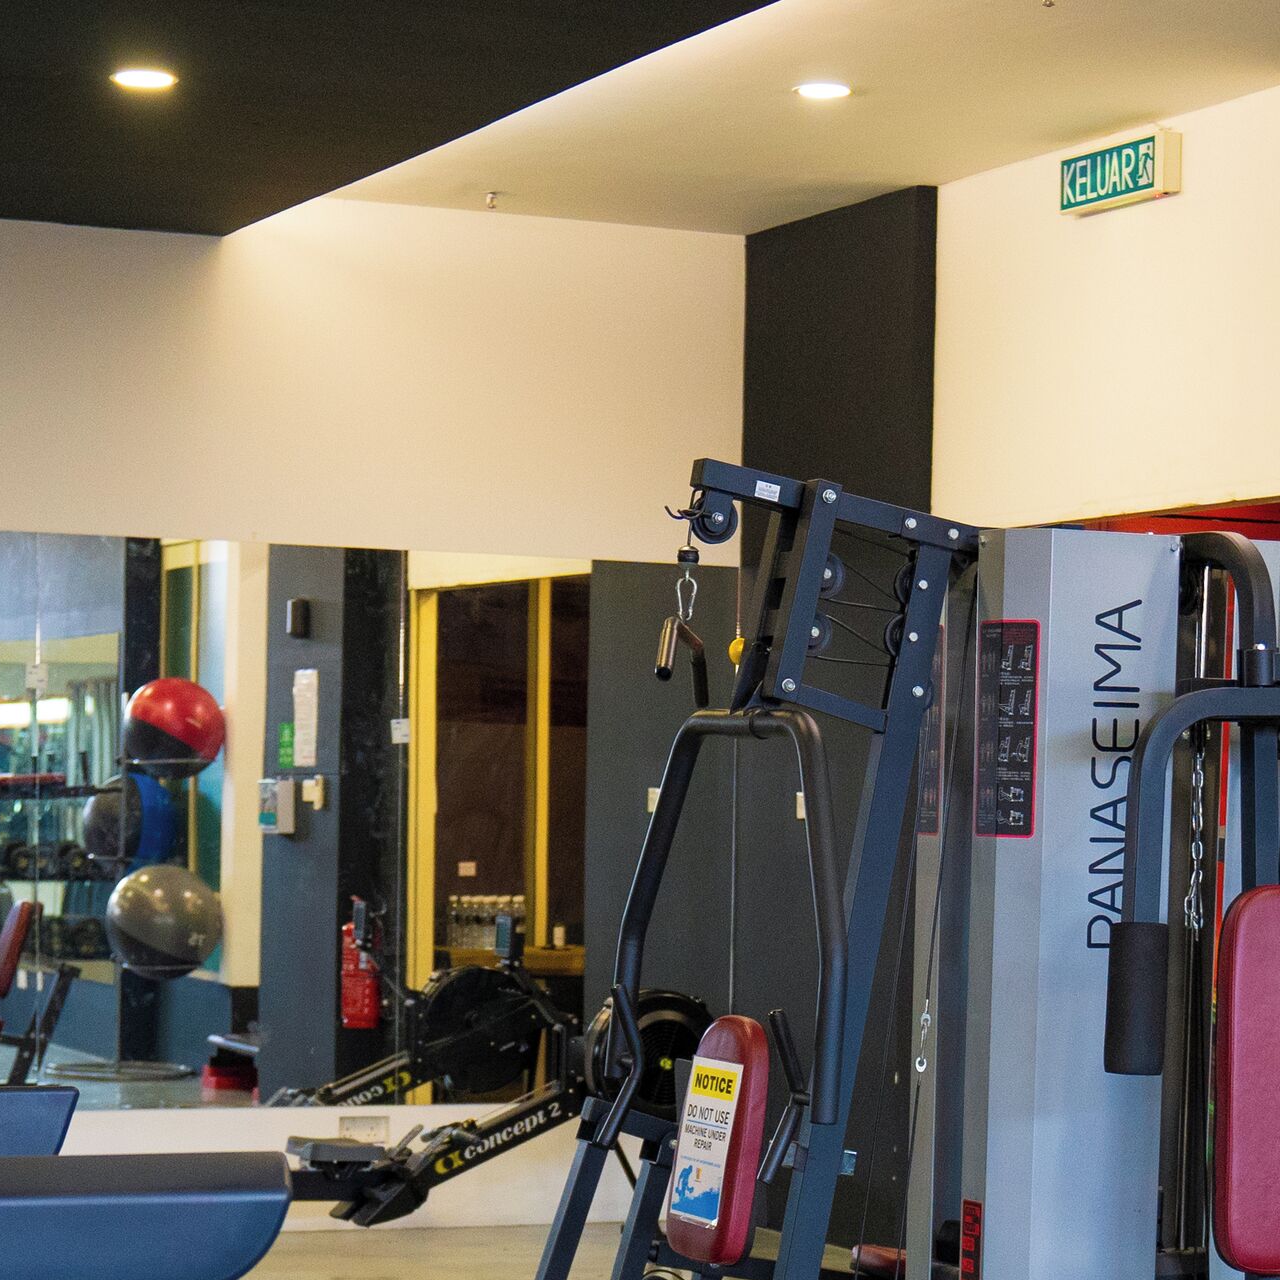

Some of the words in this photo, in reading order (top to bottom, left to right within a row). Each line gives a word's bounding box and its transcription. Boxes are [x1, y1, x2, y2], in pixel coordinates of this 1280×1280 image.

[1063, 148, 1135, 205] KELUAR
[1086, 598, 1143, 949] PANASEIMA
[694, 1072, 734, 1094] NOTICE
[687, 1103, 698, 1118] DO
[699, 1105, 714, 1121] NOT
[714, 1109, 730, 1125] USE
[463, 1108, 549, 1161] concept
[548, 1102, 562, 1118] 2
[684, 1123, 708, 1138] MACHINE
[707, 1128, 727, 1142] UNDER
[693, 1138, 713, 1151] REPAIR
